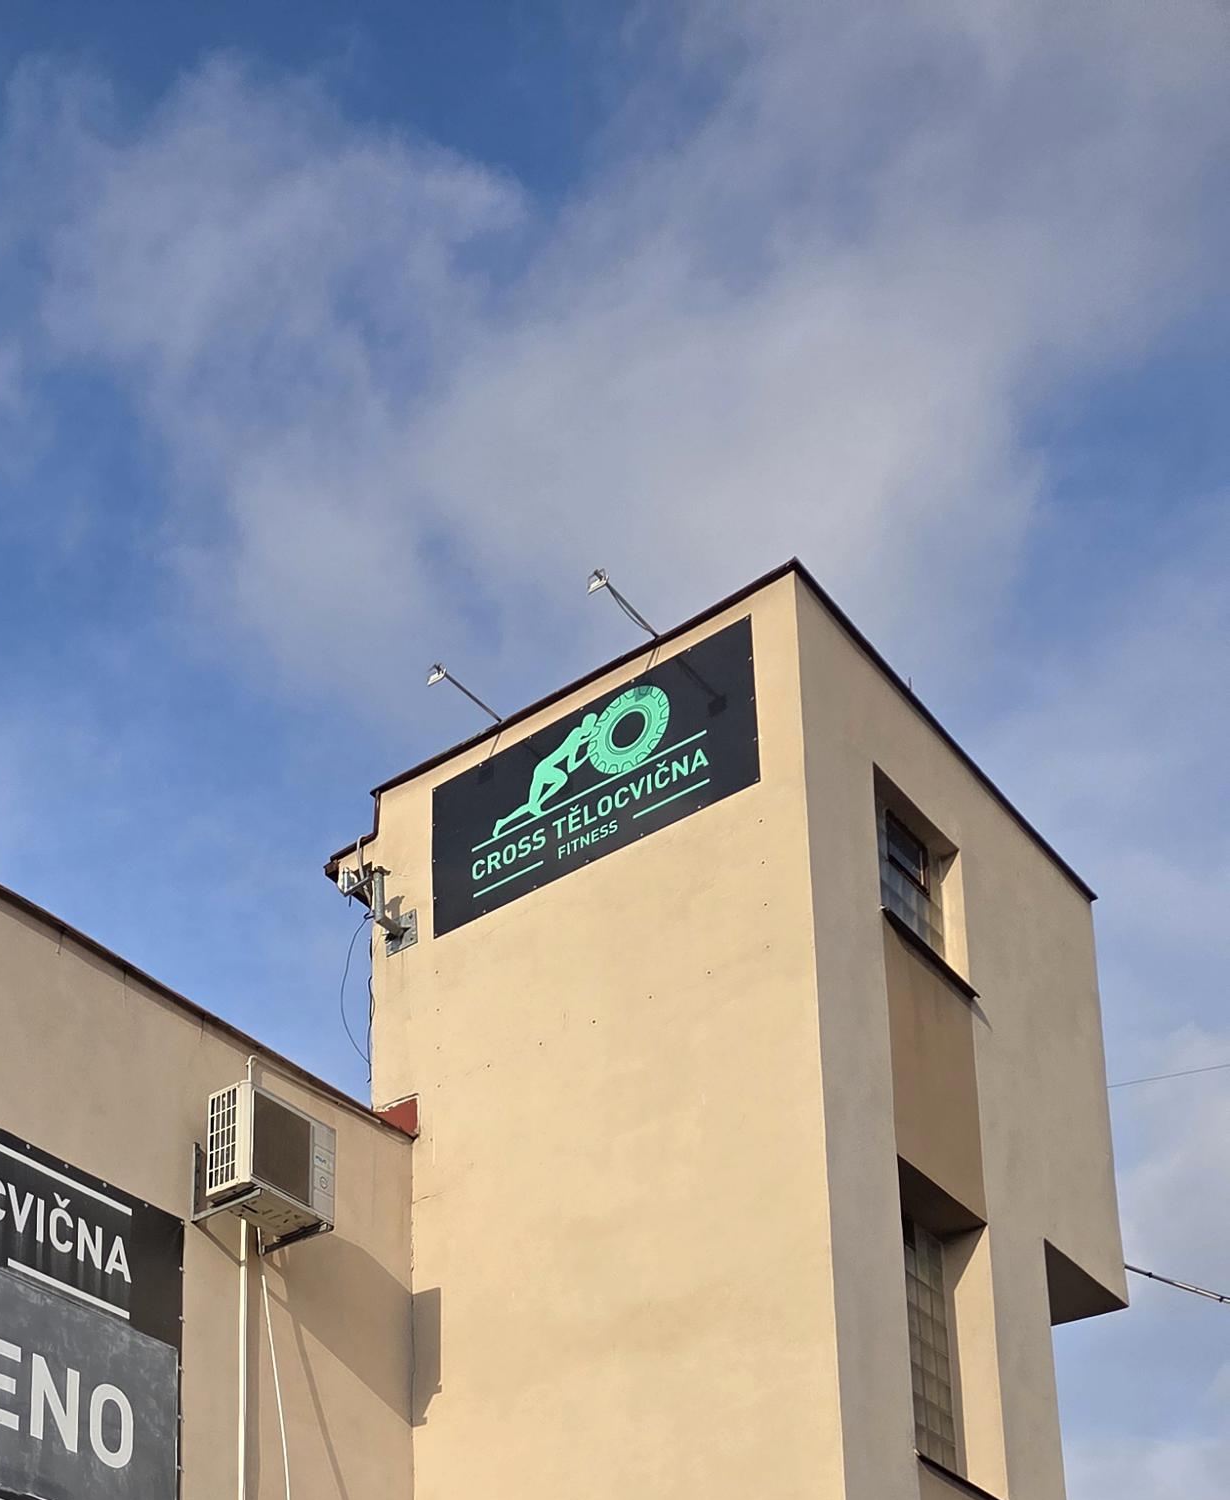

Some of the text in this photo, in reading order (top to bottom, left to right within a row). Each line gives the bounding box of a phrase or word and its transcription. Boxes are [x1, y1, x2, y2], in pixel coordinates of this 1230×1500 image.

[471, 748, 709, 881] CROSS TĚLOCVIČNA
[557, 819, 618, 860] FITNESS
